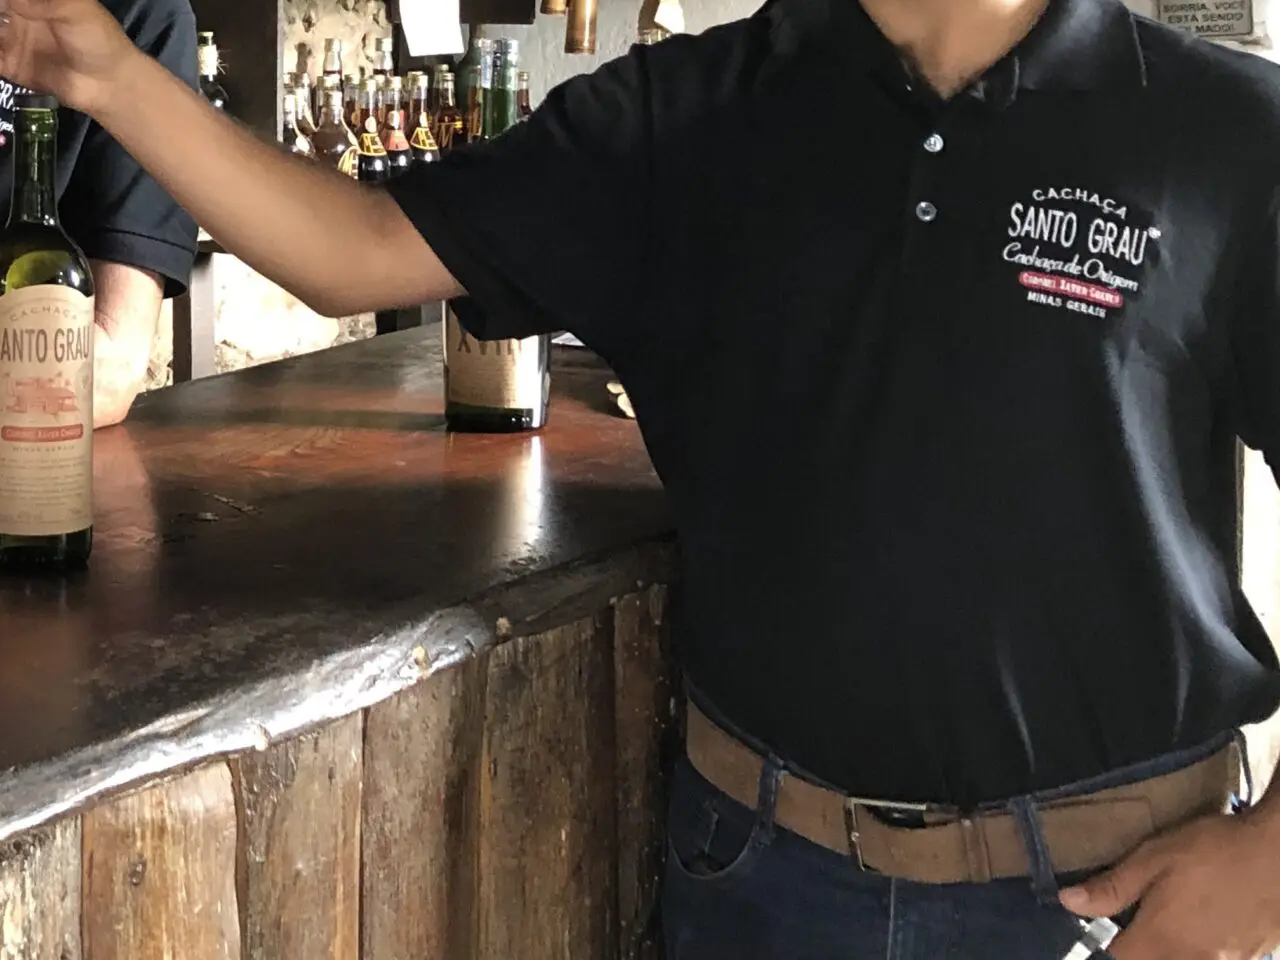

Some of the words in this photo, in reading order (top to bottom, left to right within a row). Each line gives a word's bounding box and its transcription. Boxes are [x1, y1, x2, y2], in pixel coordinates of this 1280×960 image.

[1032, 188, 1127, 220] CACHAÇA
[1008, 202, 1078, 248] SANTO
[1083, 258, 1139, 291] Origem
[10, 305, 77, 322] CACHAÇA
[1027, 291, 1062, 307] MINAS
[1066, 299, 1107, 319] GERAIS
[53, 325, 90, 364] GRAU
